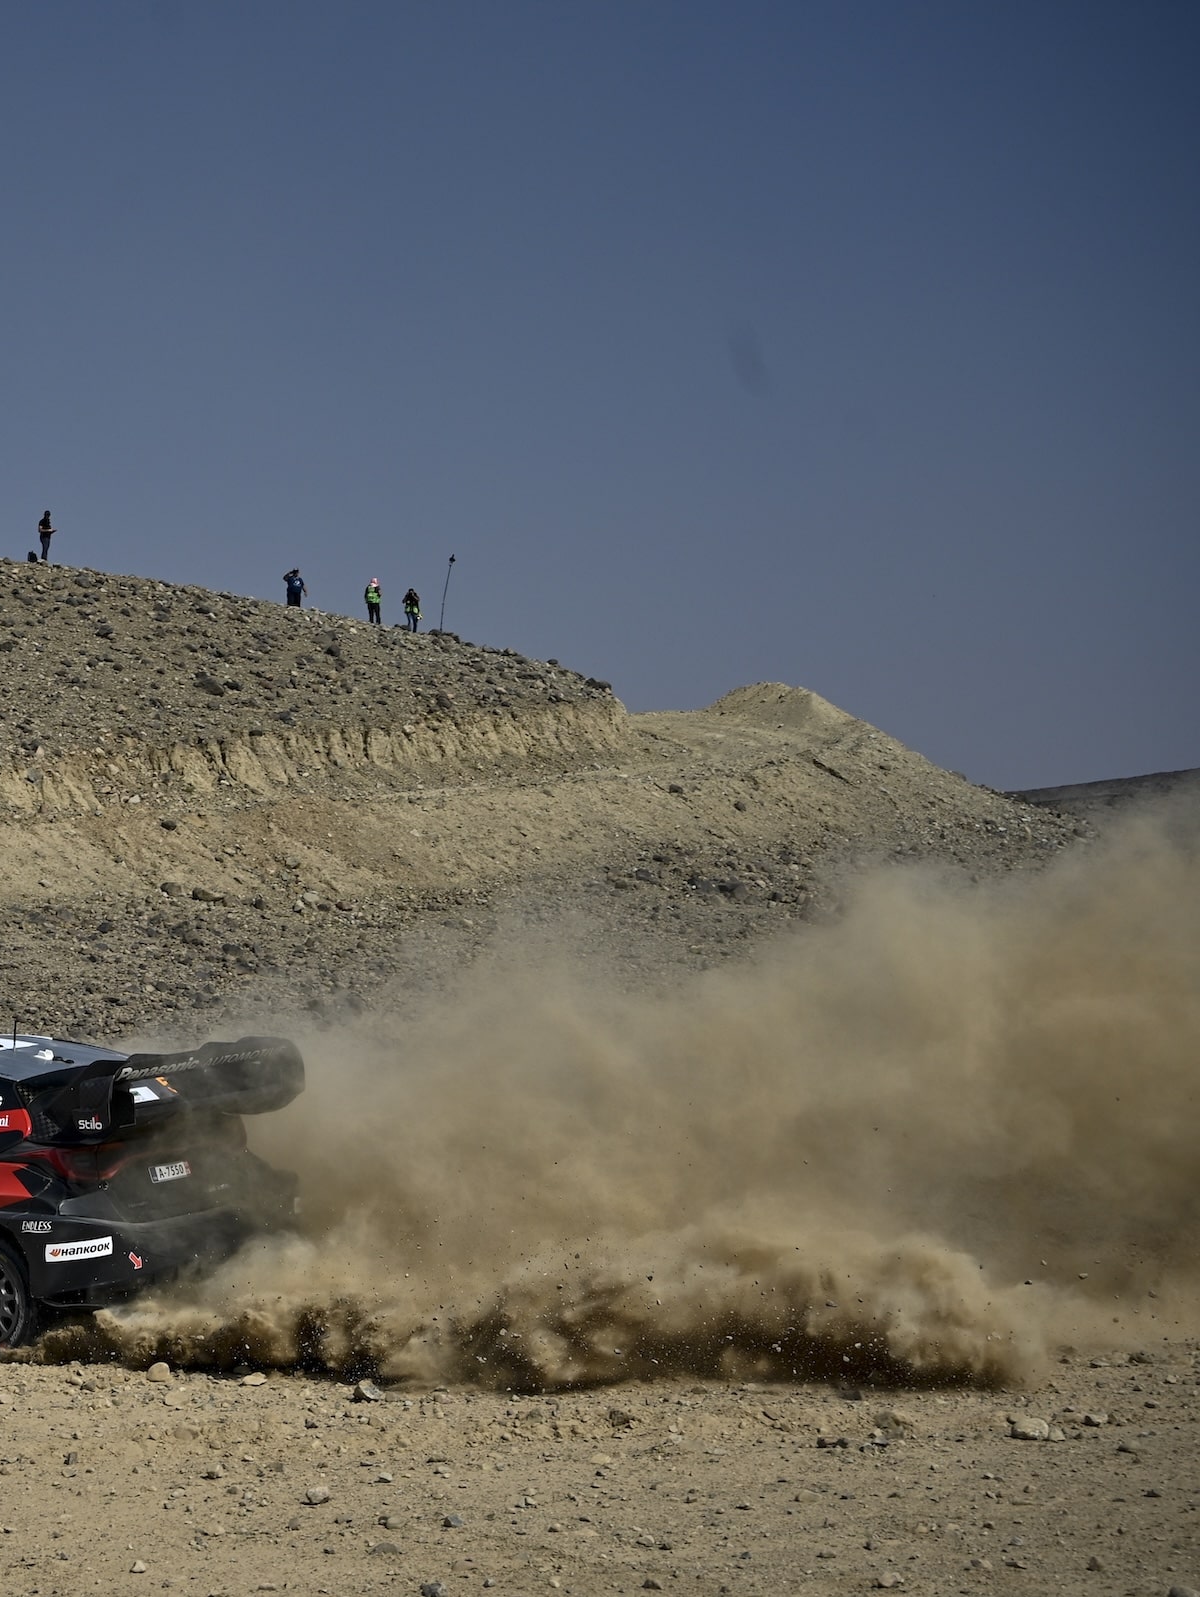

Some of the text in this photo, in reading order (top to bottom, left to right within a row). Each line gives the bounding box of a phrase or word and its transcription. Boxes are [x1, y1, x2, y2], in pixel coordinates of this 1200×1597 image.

[115, 1046, 281, 1082] Panasonic AUTOMOTI
[158, 1164, 185, 1179] A-7550
